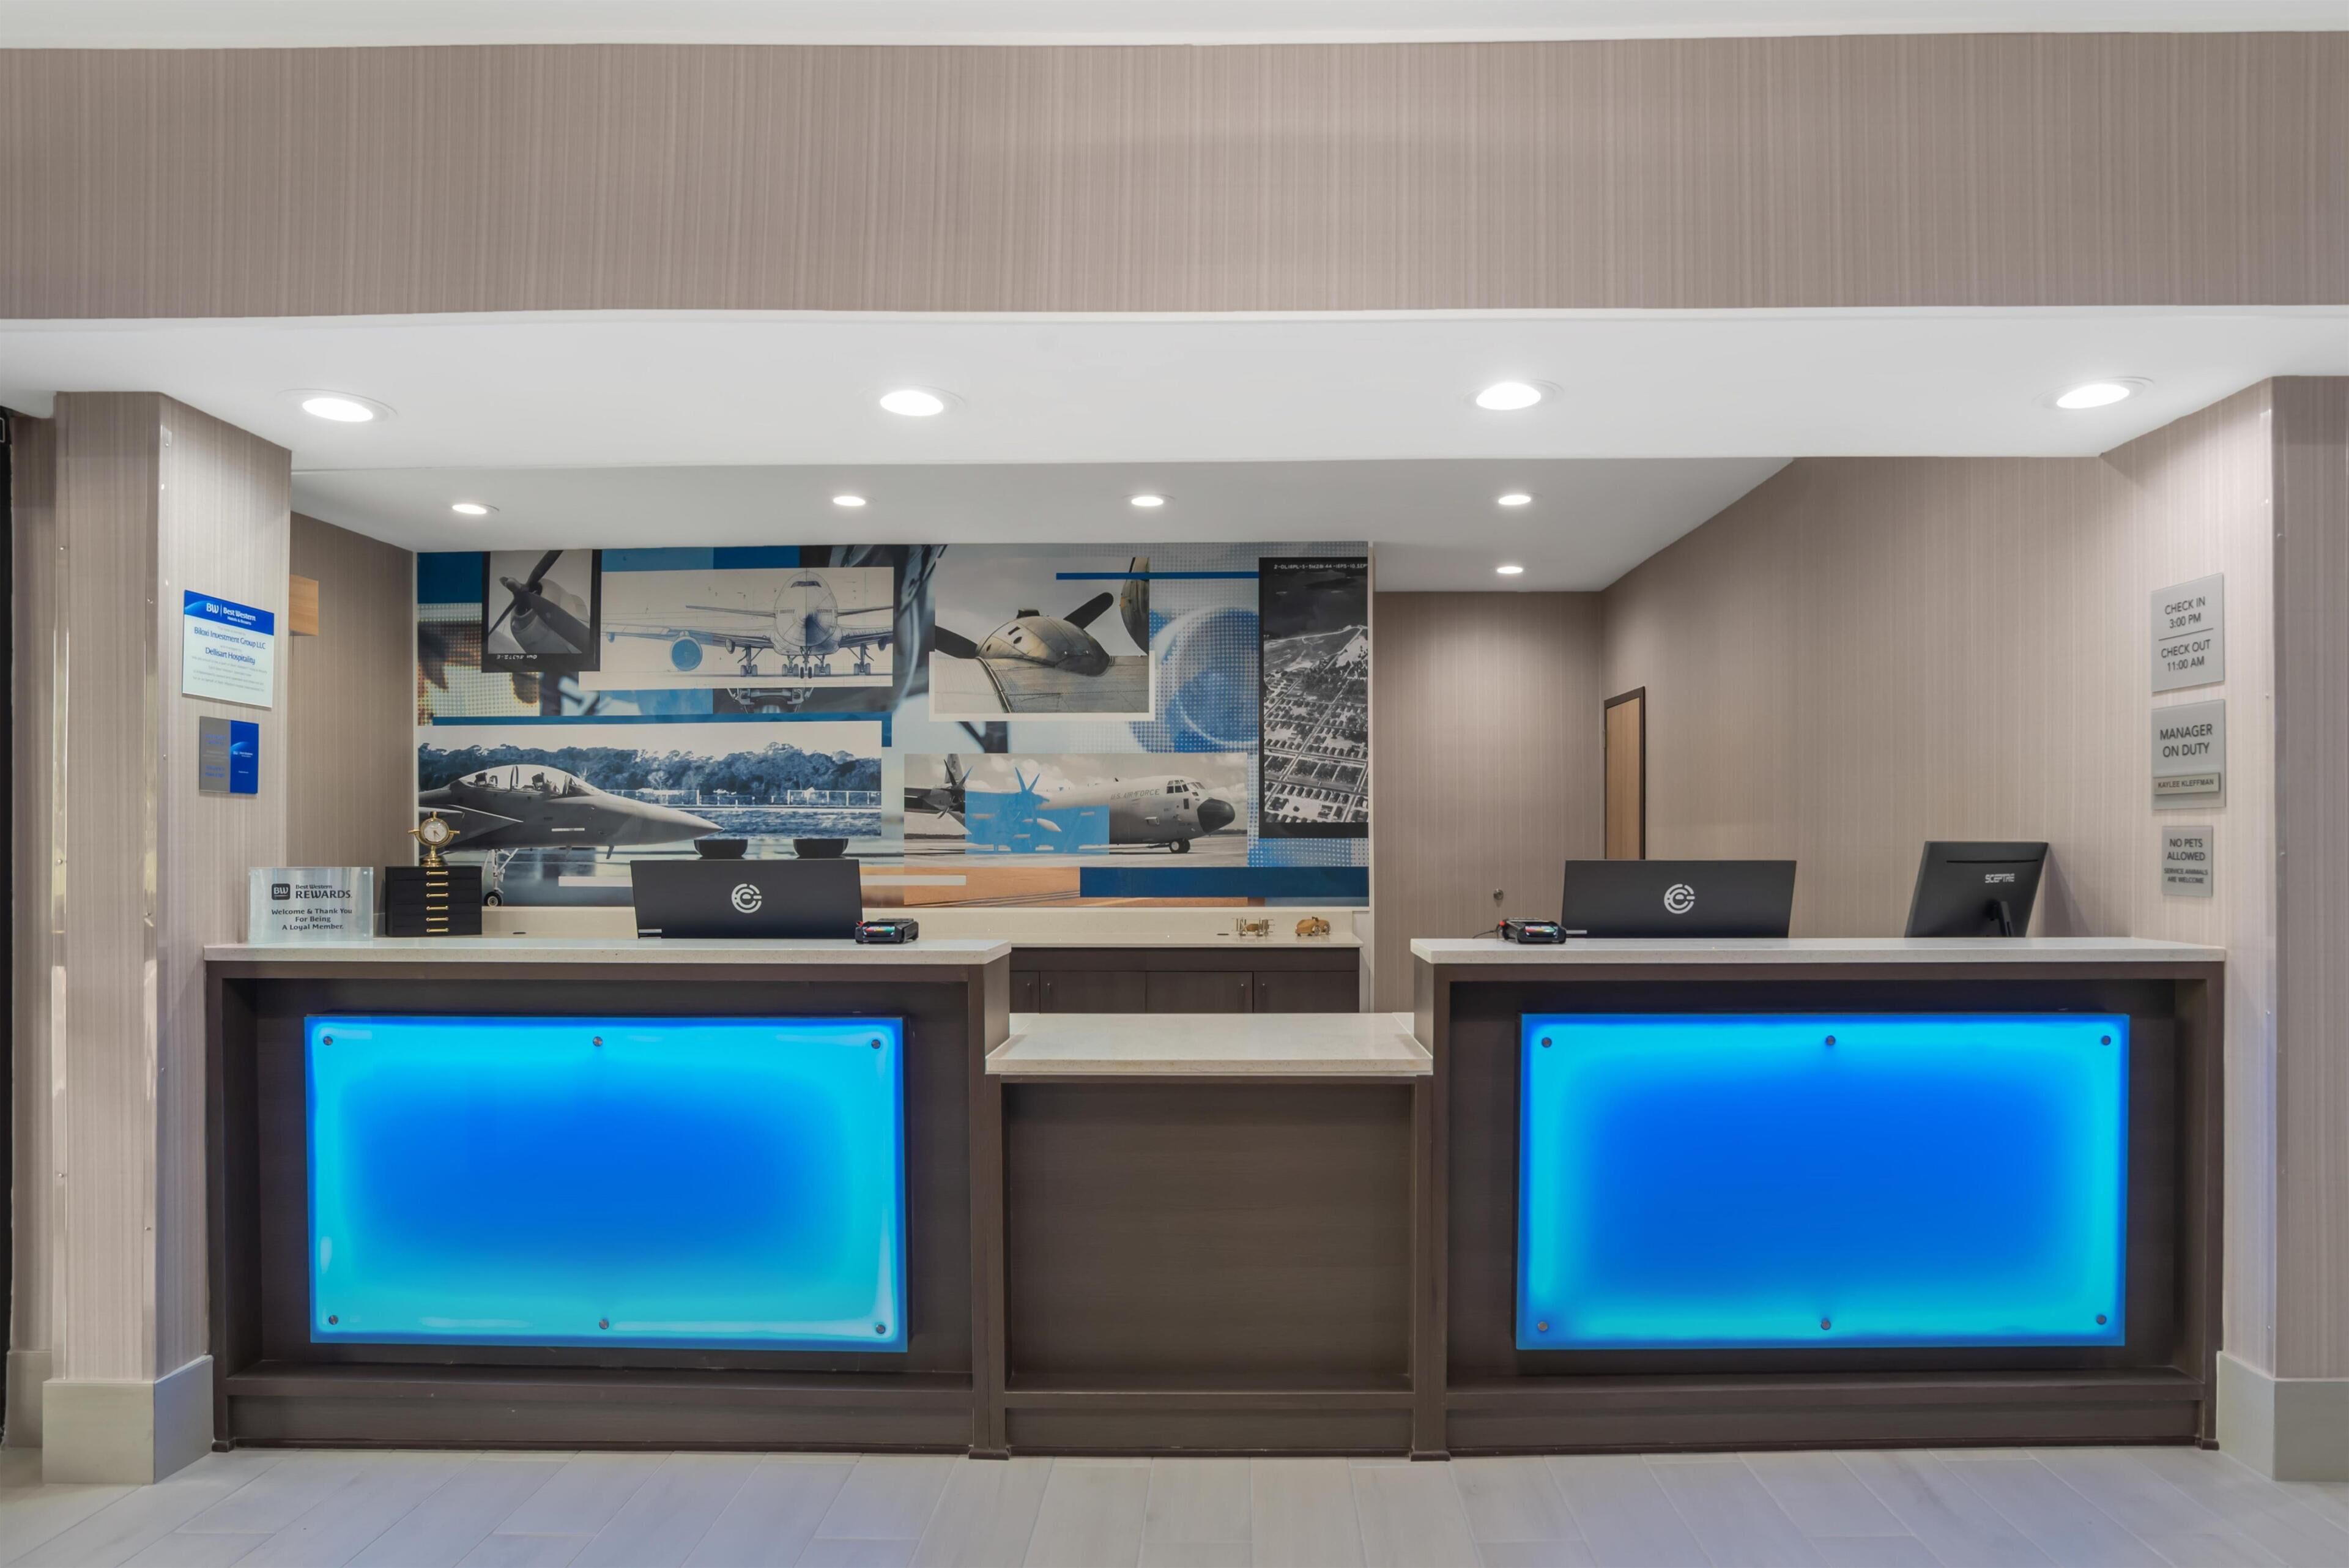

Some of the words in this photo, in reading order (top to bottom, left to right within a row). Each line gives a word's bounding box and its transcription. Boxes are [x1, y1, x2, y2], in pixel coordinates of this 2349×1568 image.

[206, 603, 219, 614] BW
[223, 607, 235, 615] Best
[236, 611, 256, 621] Western
[2165, 598, 2194, 615] CHECK
[2196, 596, 2206, 608] IN
[2169, 616, 2186, 629] 3:00
[2188, 612, 2201, 624] PM
[195, 626, 209, 636] Biloxi
[210, 631, 239, 643] Investment
[240, 637, 256, 648] Group
[256, 641, 265, 649] LLC
[206, 647, 227, 658] Dellisart
[228, 653, 255, 665] Hospitality
[2161, 642, 2190, 658] CHECK
[2192, 639, 2211, 652] OUT
[2167, 658, 2188, 672] 11:00
[2190, 656, 2205, 667] AM
[2160, 723, 2212, 741] MANAGER
[2163, 745, 2179, 757] ON
[2182, 742, 2210, 756] DUTY
[2184, 839, 2202, 847] PETS
[2167, 852, 2205, 861] ALLOWED
[1985, 873, 2014, 883] SCEPTRE
[296, 890, 351, 899] REWARDS
